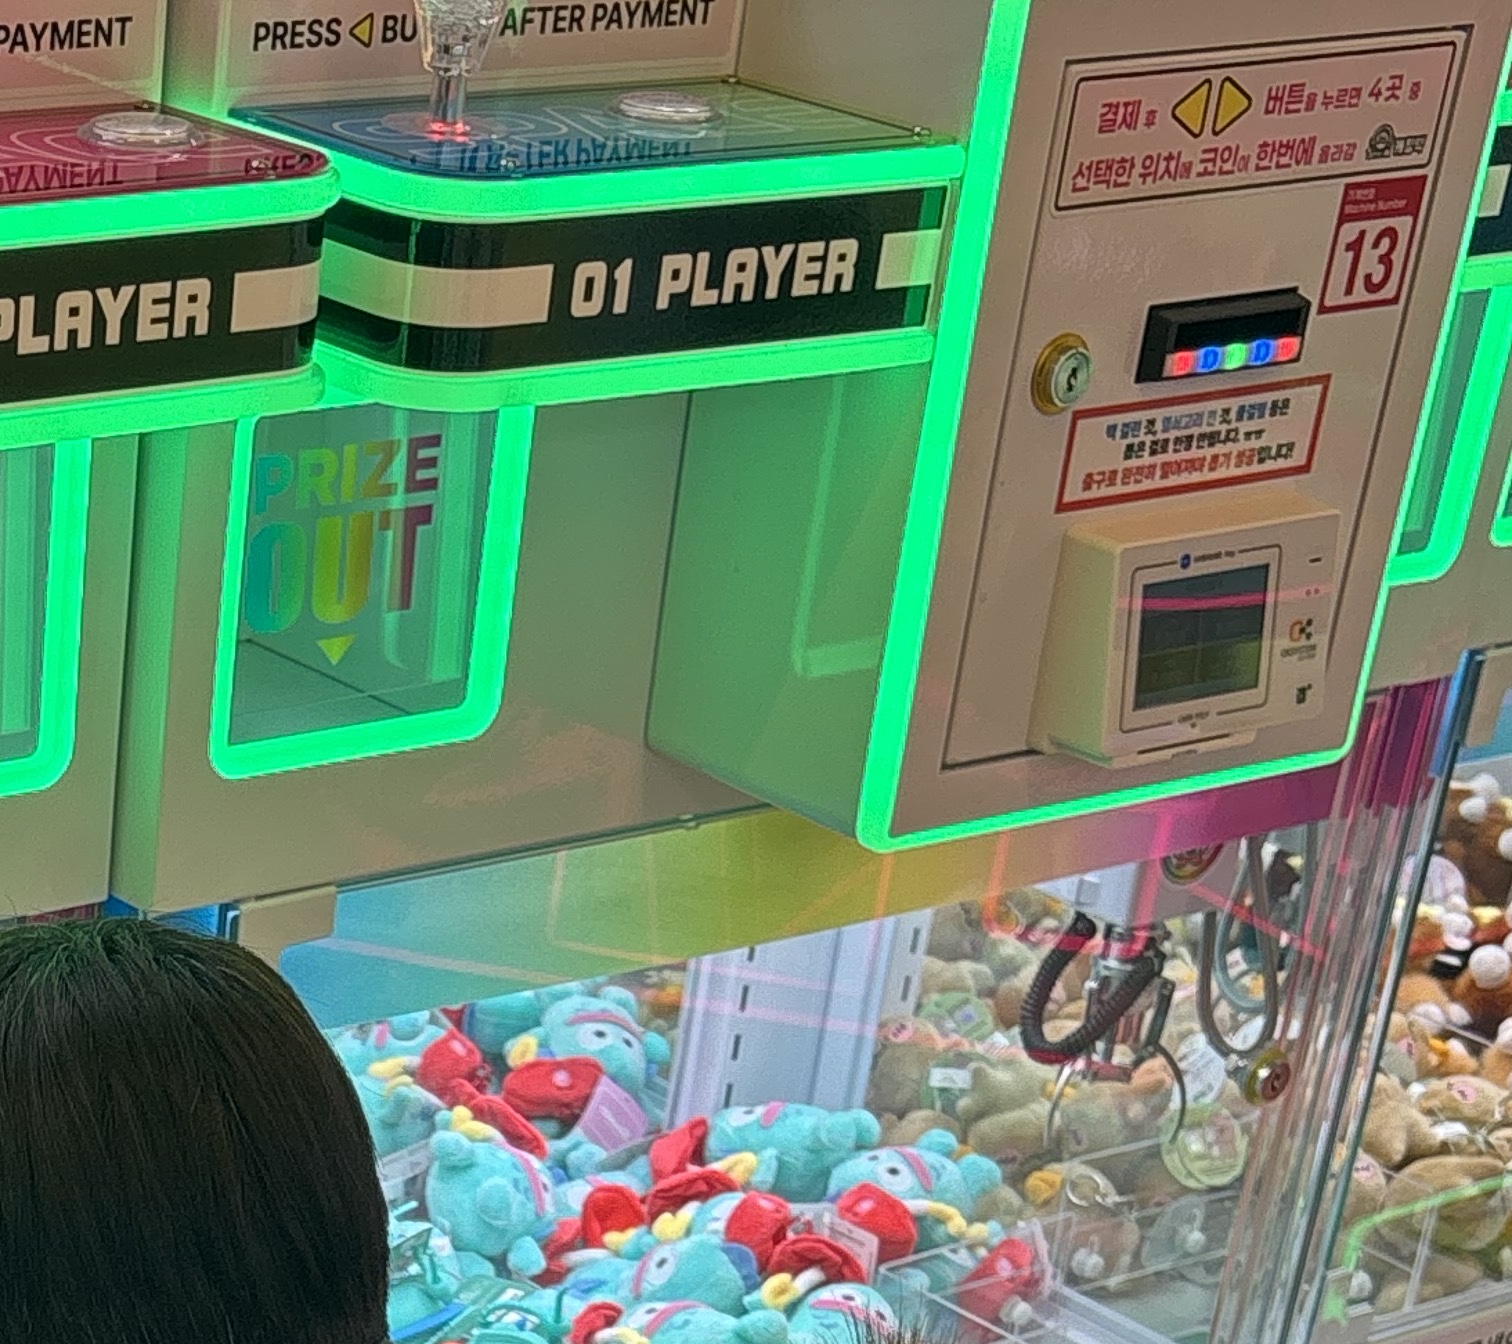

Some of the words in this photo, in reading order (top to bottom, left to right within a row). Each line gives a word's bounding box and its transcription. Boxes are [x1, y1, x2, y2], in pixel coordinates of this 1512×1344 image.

[253, 18, 341, 52] PRESS
[499, 5, 586, 37] AFTER
[590, 0, 713, 31] PAYMENT
[1097, 99, 1141, 134] 결제
[1070, 156, 1135, 193] 선택한
[1195, 143, 1250, 176] 코인이
[1254, 135, 1318, 173] 한번에
[570, 257, 633, 318] 01
[655, 237, 858, 311] PLAYER
[1344, 226, 1399, 297] 13
[255, 433, 443, 516] PRIZE
[243, 503, 433, 634] OUT
